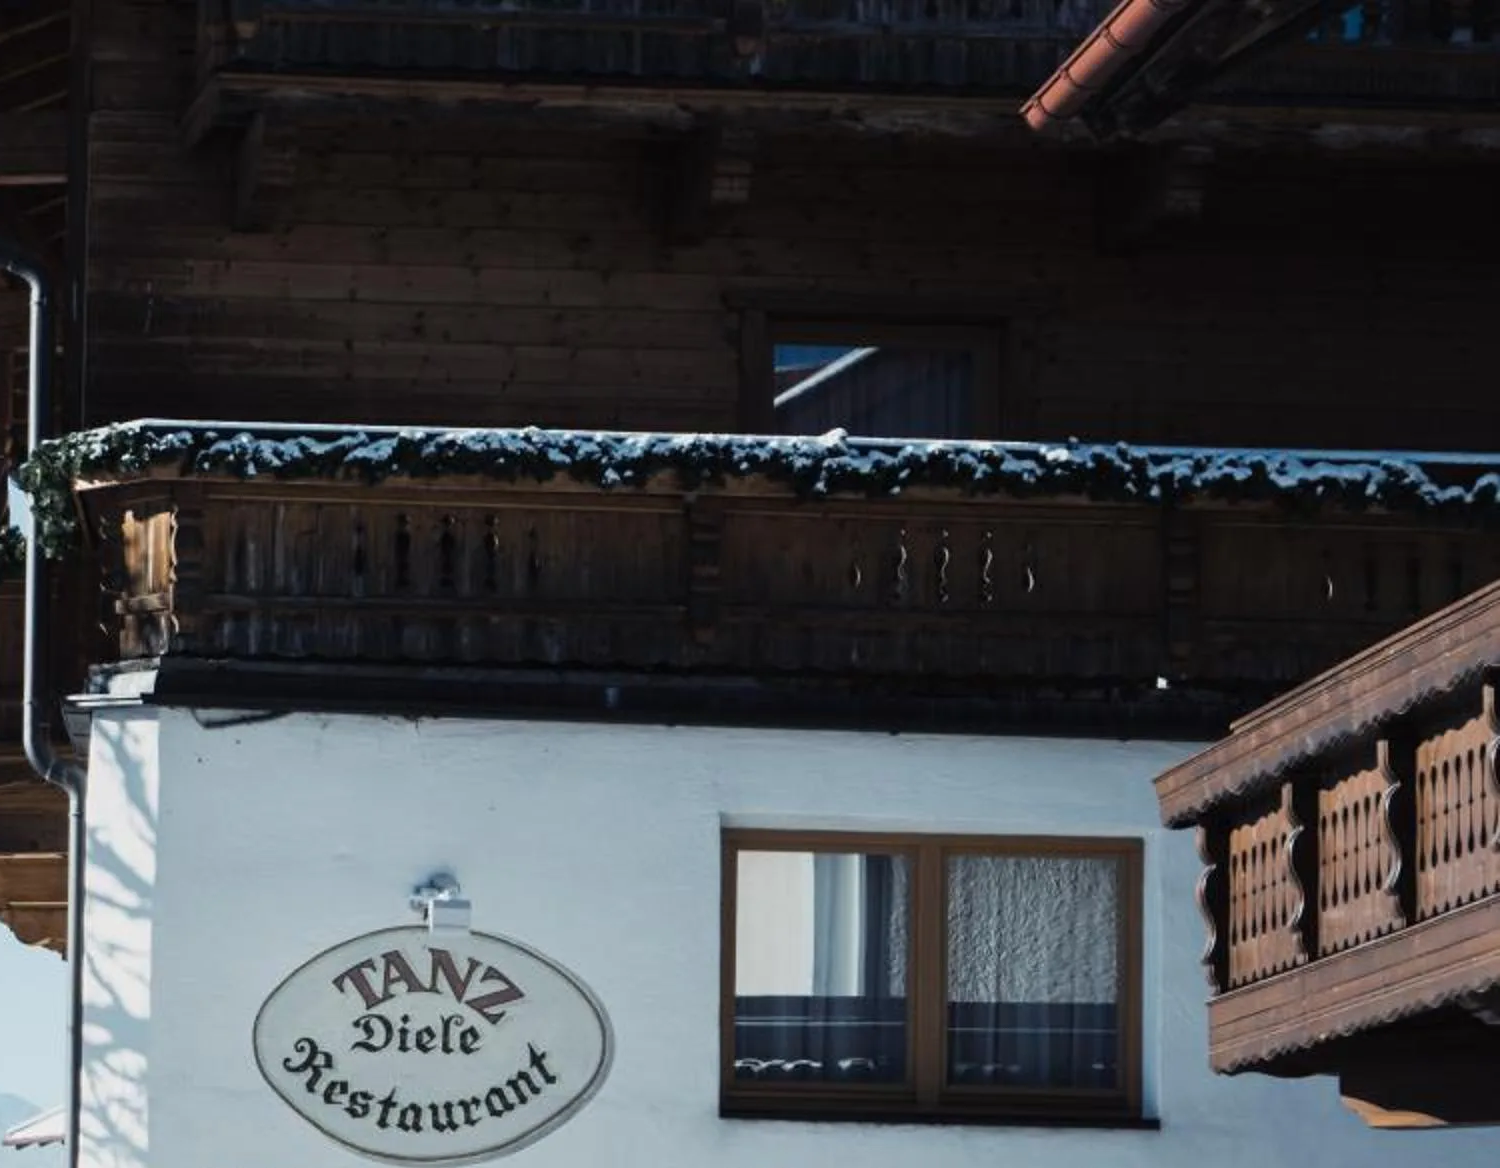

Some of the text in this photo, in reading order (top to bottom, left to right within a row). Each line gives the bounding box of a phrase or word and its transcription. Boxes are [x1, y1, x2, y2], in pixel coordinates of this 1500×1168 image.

[332, 947, 526, 1026] TANZ
[351, 1014, 482, 1055] Diele
[283, 1038, 557, 1133] Restaurant
